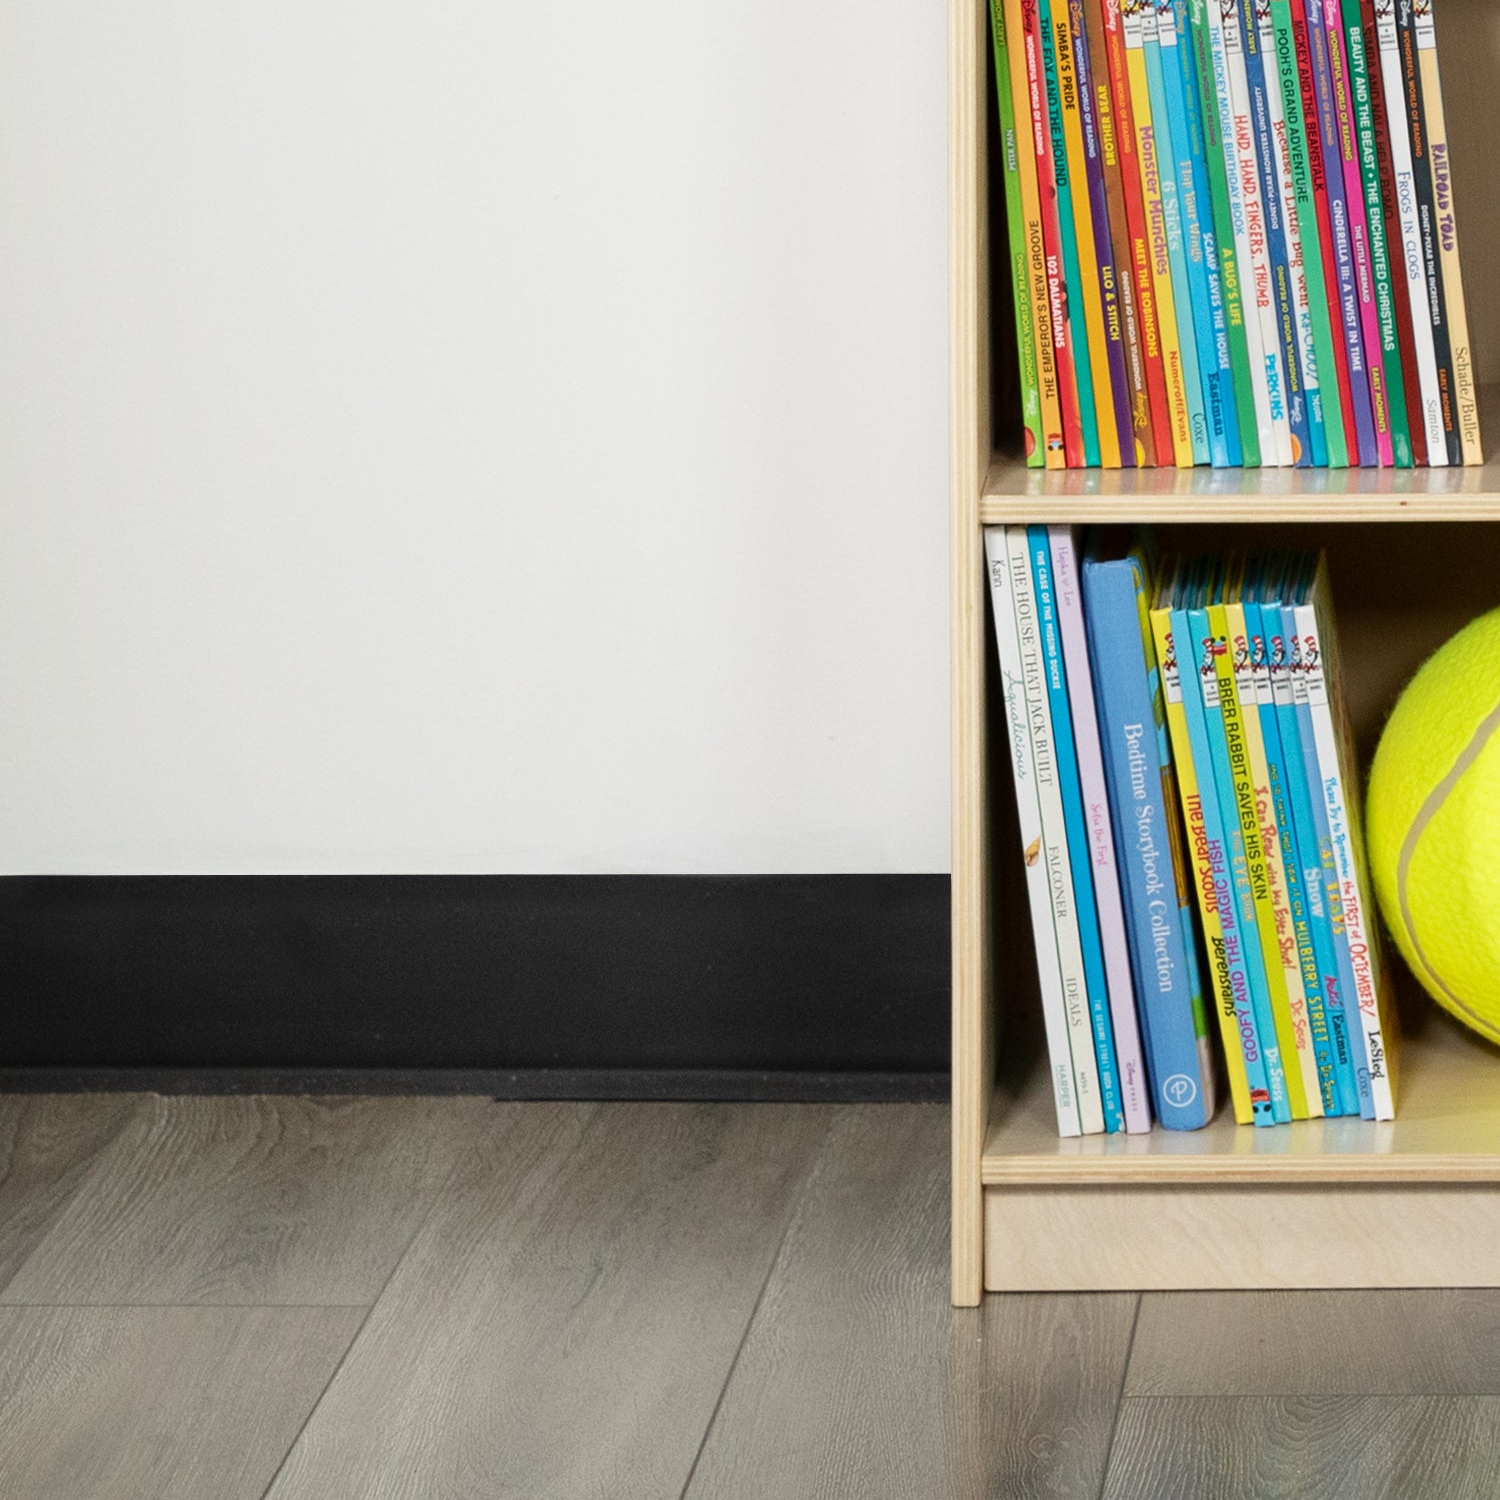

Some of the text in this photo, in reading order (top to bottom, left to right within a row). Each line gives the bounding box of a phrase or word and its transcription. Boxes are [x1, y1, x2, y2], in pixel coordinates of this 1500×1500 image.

[1056, 23, 1075, 110] SIMBA'S PRIDE
[1247, 32, 1256, 54] EARLY
[1097, 85, 1116, 166] BROTHER BEAR
[1210, 26, 1244, 235] THE MICKEY MOUSE BIRTHDAY BOOK
[1254, 86, 1272, 174] MONSTERS UNIVERSITY
[1278, 28, 1308, 203] POOH'S GRAND ADVENTURE
[1294, 20, 1324, 192] MICKEY AND THE BEANSTALK
[1139, 126, 1167, 276] Monster Munchies
[1162, 181, 1180, 251] 6 Sticks
[1179, 160, 1202, 263] Flap Your Wings
[1273, 120, 1309, 307] Because a Little Bug went
[1349, 27, 1394, 351] BEAUTY AND THE BEAST THE ENCHANTED CHRISTMAS
[1431, 143, 1454, 251] RAILROAD TOAD
[1047, 255, 1065, 348] 102 DALMATIANS
[1103, 266, 1119, 340] LILO & STITCH
[1134, 238, 1157, 358] MEET THE ROBINSONS
[1203, 233, 1228, 369] SCAMP SAVES THE HOUSE
[1222, 248, 1241, 325] A BUG'S LIFE
[1254, 265, 1269, 308] THUMB
[1333, 200, 1361, 371] CINDERELLA III: A TWIST IN TIME
[1354, 225, 1370, 304] THE LITTLE MERMAID
[1428, 278, 1440, 325] INCREDIBLES
[1029, 221, 1055, 399] THE EMPEROR'S NEW GROOVE
[1169, 351, 1187, 442] Numeroff/Evans
[1192, 413, 1205, 443] Coxe
[1208, 371, 1224, 436] Eastman
[1265, 353, 1283, 420] PERKINS
[1371, 367, 1386, 434] EARLY MOMENTS
[1427, 399, 1440, 444] Samton
[1439, 368, 1452, 431] EARLY MOMENTS
[1455, 347, 1476, 445] Schade/Buller
[992, 559, 1004, 587] Kann
[1011, 552, 1052, 786] THE HOUSE THAT JACK BUILT
[1003, 671, 1027, 779] Aqualicious
[1219, 678, 1267, 900] BRER RABBIT SAVES HIS SKIN
[1048, 846, 1067, 919] FALCONER
[1124, 723, 1174, 993] Bedtime Storybook Collection
[1304, 867, 1324, 918] Snow
[1208, 840, 1258, 1062] GOOFY AND THE MAGIC FISH
[1066, 978, 1082, 1027] IDEALS
[1332, 1015, 1348, 1065] Eastman
[1058, 1065, 1070, 1108] HARPER
[1264, 1047, 1283, 1101] Dr. Seuss
[1366, 1031, 1384, 1080] LeSieg
